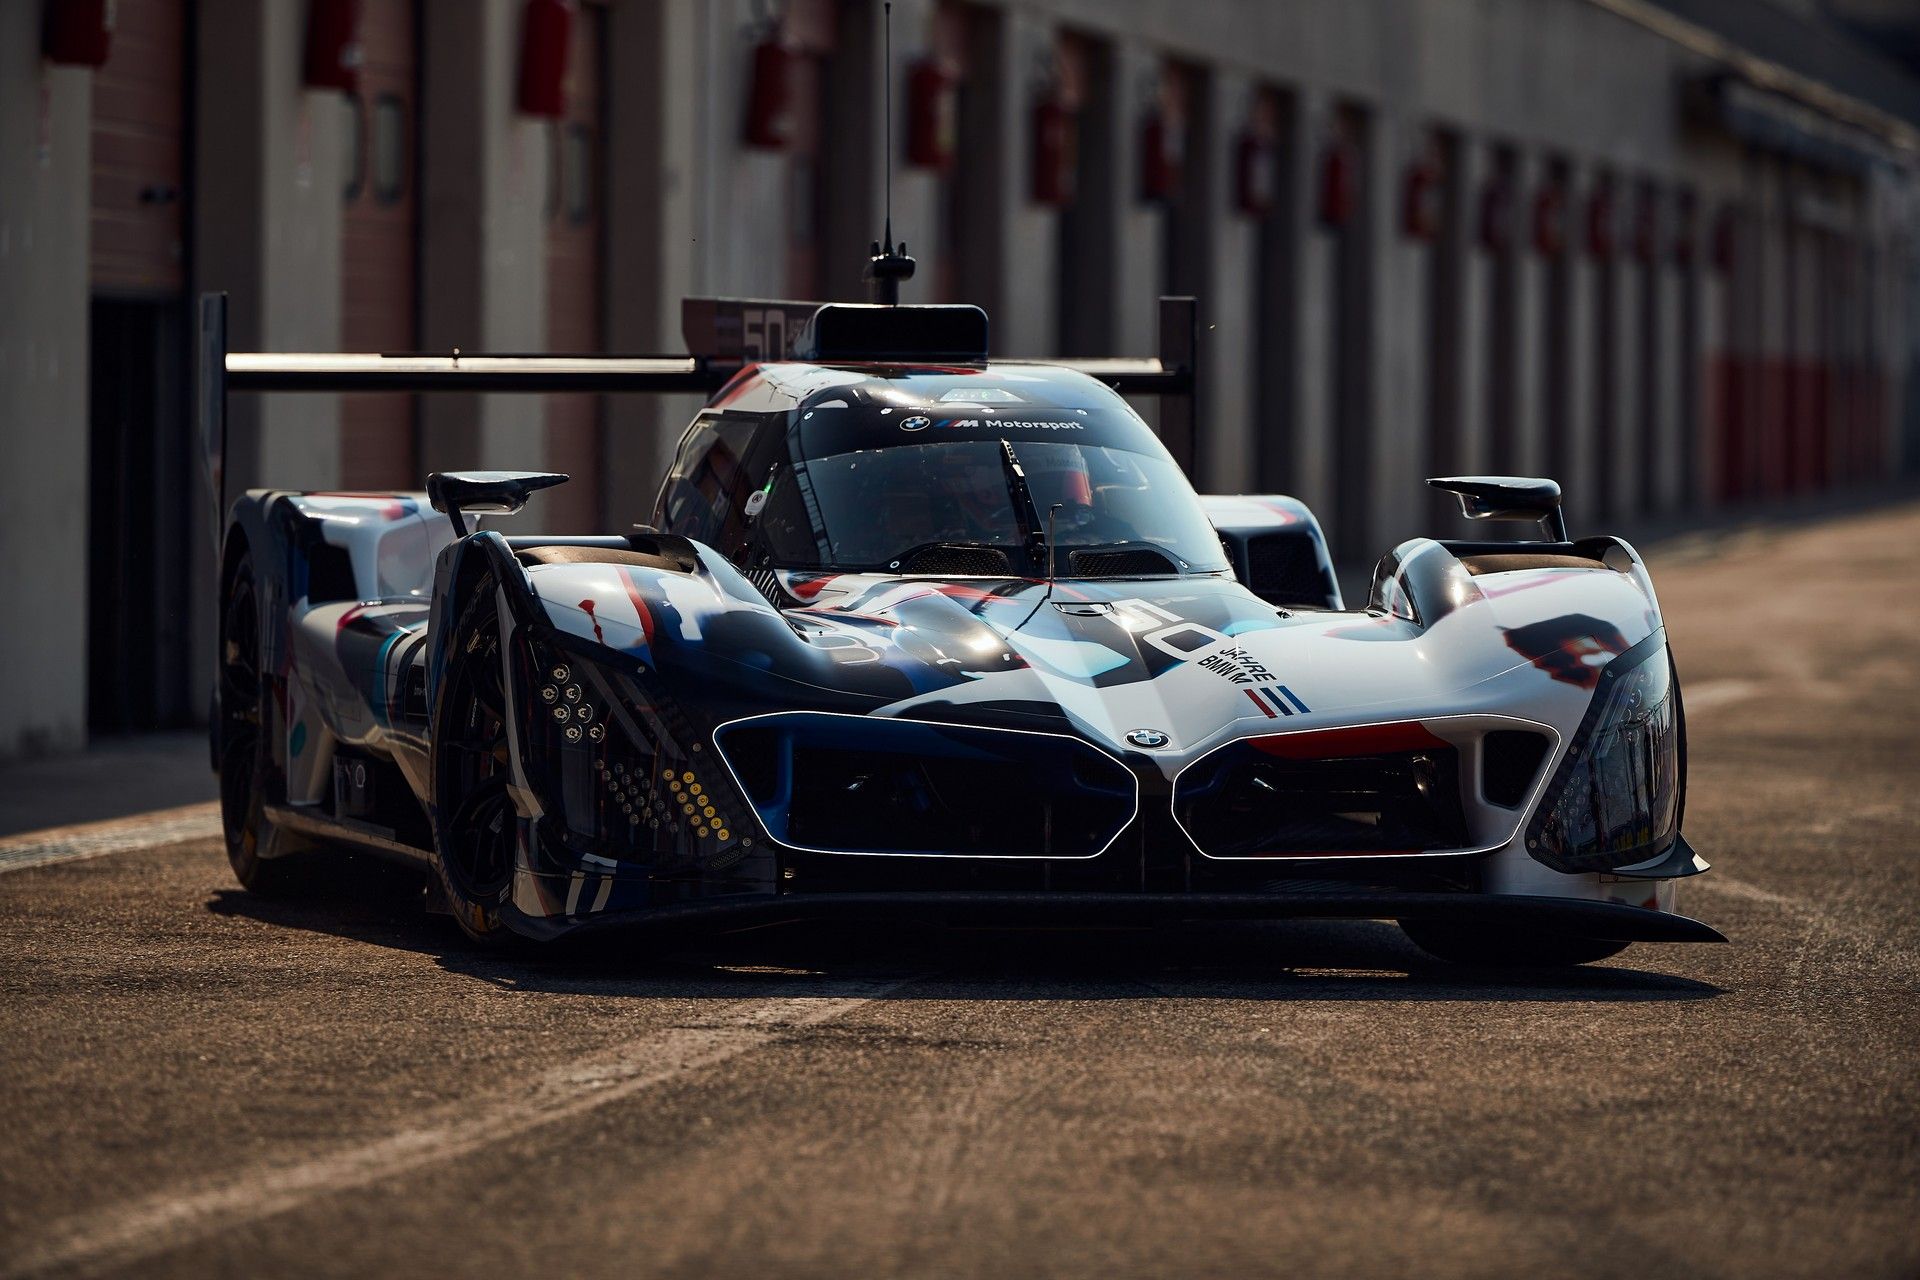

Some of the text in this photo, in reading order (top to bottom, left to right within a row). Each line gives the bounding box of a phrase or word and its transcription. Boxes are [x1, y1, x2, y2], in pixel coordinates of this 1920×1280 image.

[743, 309, 786, 361] 50
[953, 419, 1085, 430] M Motorsport
[1197, 655, 1254, 684] BMW M
[1219, 646, 1277, 682] JAHRE
